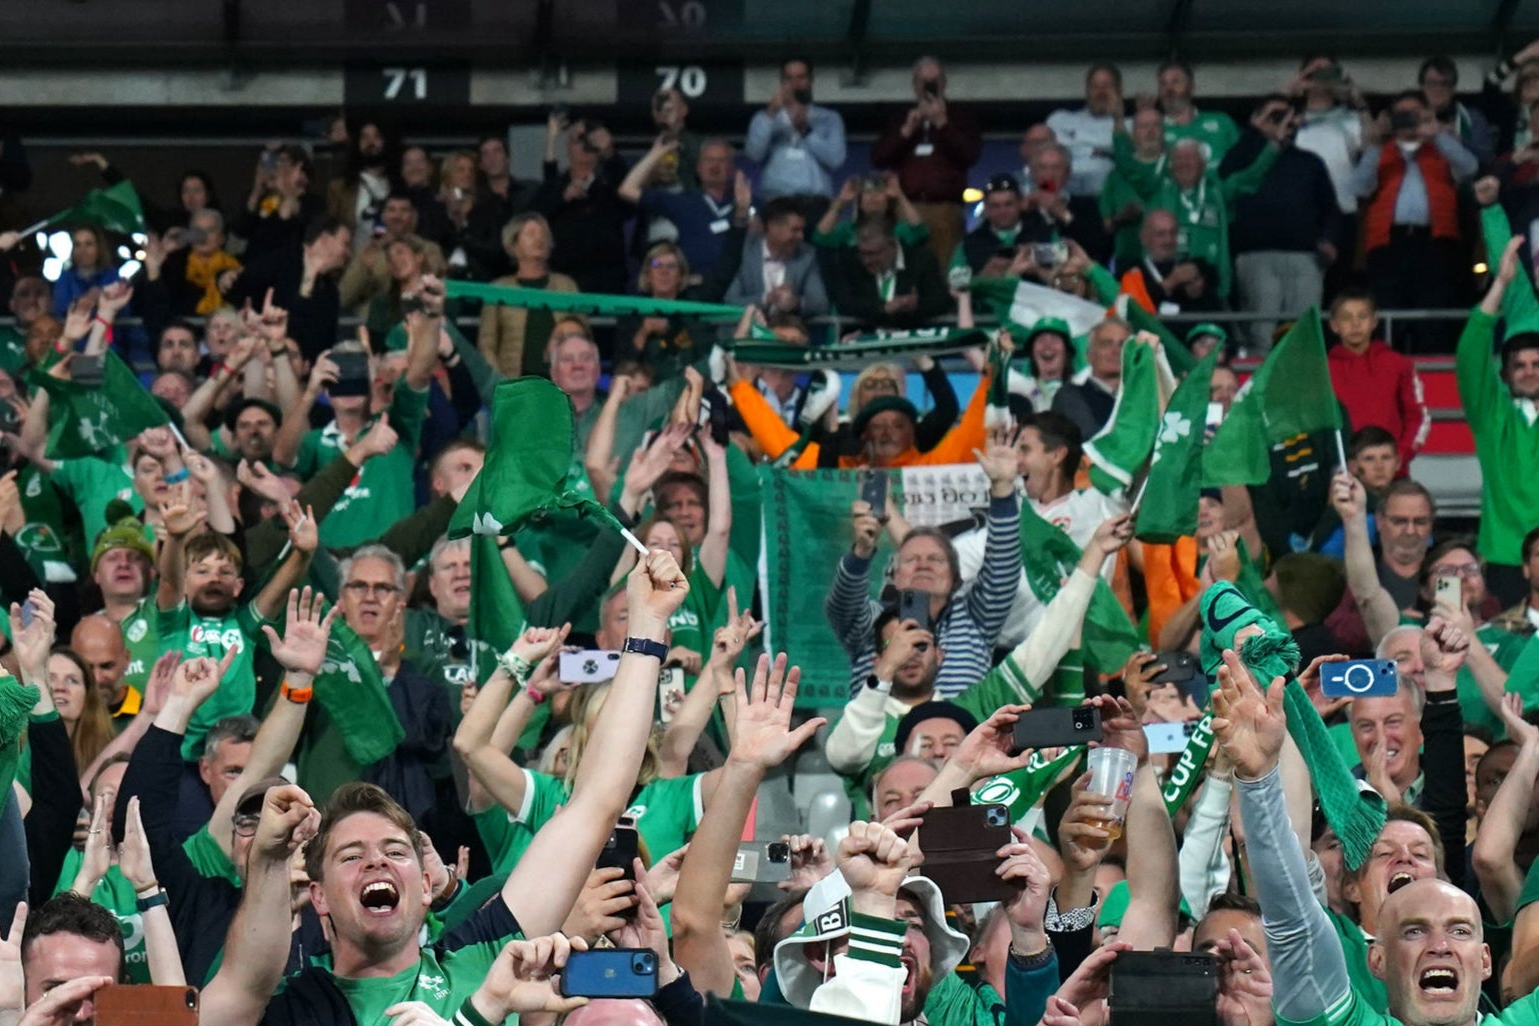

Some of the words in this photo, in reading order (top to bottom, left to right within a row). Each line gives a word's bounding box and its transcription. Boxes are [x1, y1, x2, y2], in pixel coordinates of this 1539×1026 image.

[384, 69, 427, 99] 71
[656, 67, 707, 97] 70
[1163, 750, 1197, 803] CUP
